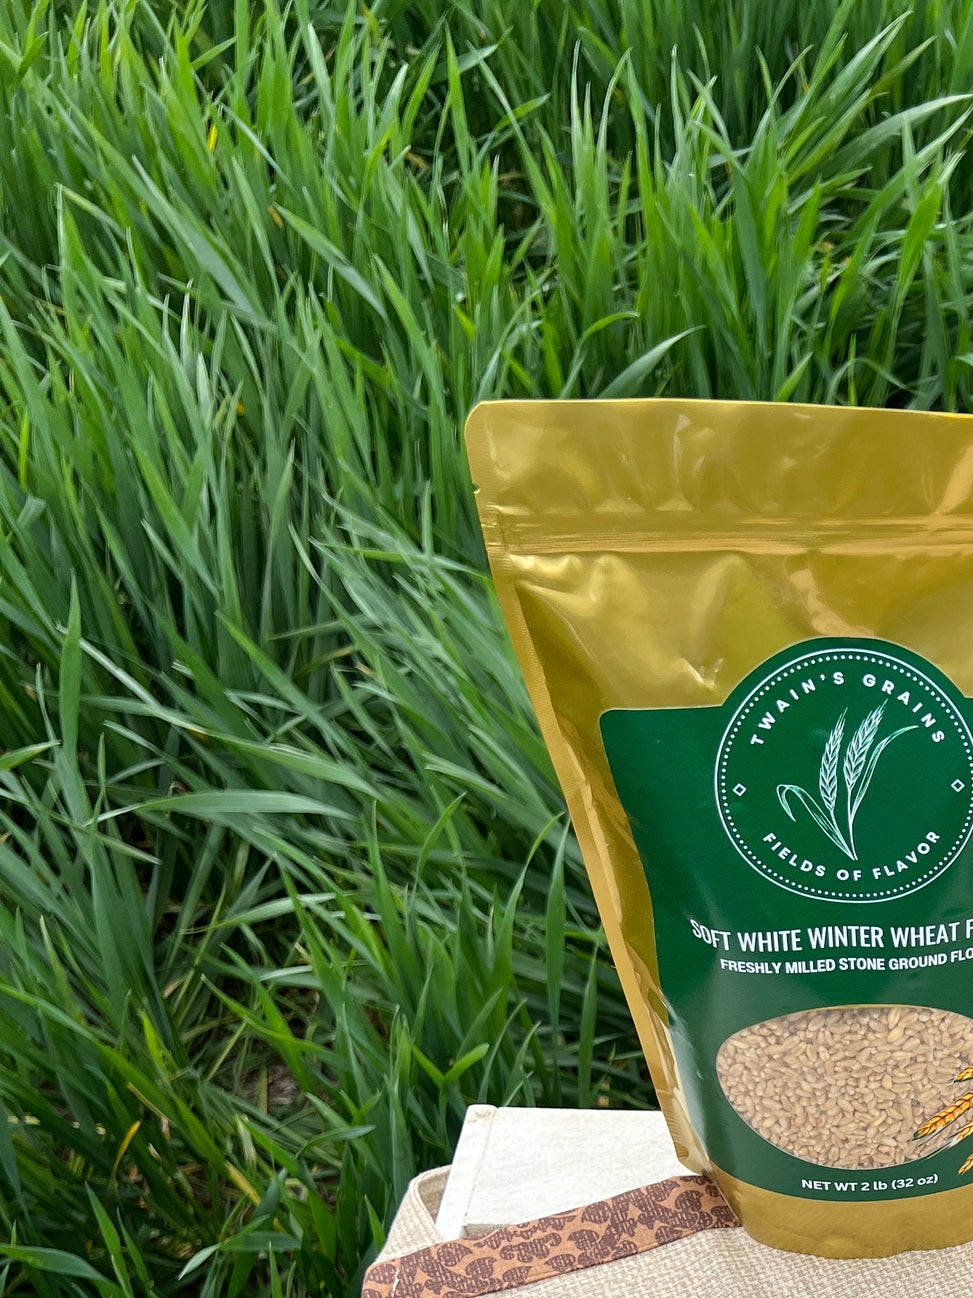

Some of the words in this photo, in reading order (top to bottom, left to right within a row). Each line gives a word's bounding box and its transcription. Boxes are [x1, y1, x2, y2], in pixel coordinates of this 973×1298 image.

[750, 671, 845, 746] TWAIN'S
[862, 673, 945, 743] GRAINS
[762, 832, 826, 877] FIELDS
[836, 868, 862, 881] OF
[872, 831, 940, 880] FLAVOR
[689, 918, 731, 951] SOFT
[737, 929, 803, 952] WHITE
[807, 925, 884, 949] WINTER
[890, 921, 960, 948] WHEAT
[719, 958, 782, 974] FRESHLY
[785, 959, 836, 974] MILLED
[839, 957, 885, 971] STONE
[888, 953, 948, 970] GROUND
[801, 1179, 831, 1190] NET
[834, 1182, 858, 1191] WT
[861, 1181, 870, 1191] 2
[873, 1181, 888, 1190] lb
[891, 1178, 914, 1190] (32
[917, 1173, 939, 1186] oz)
